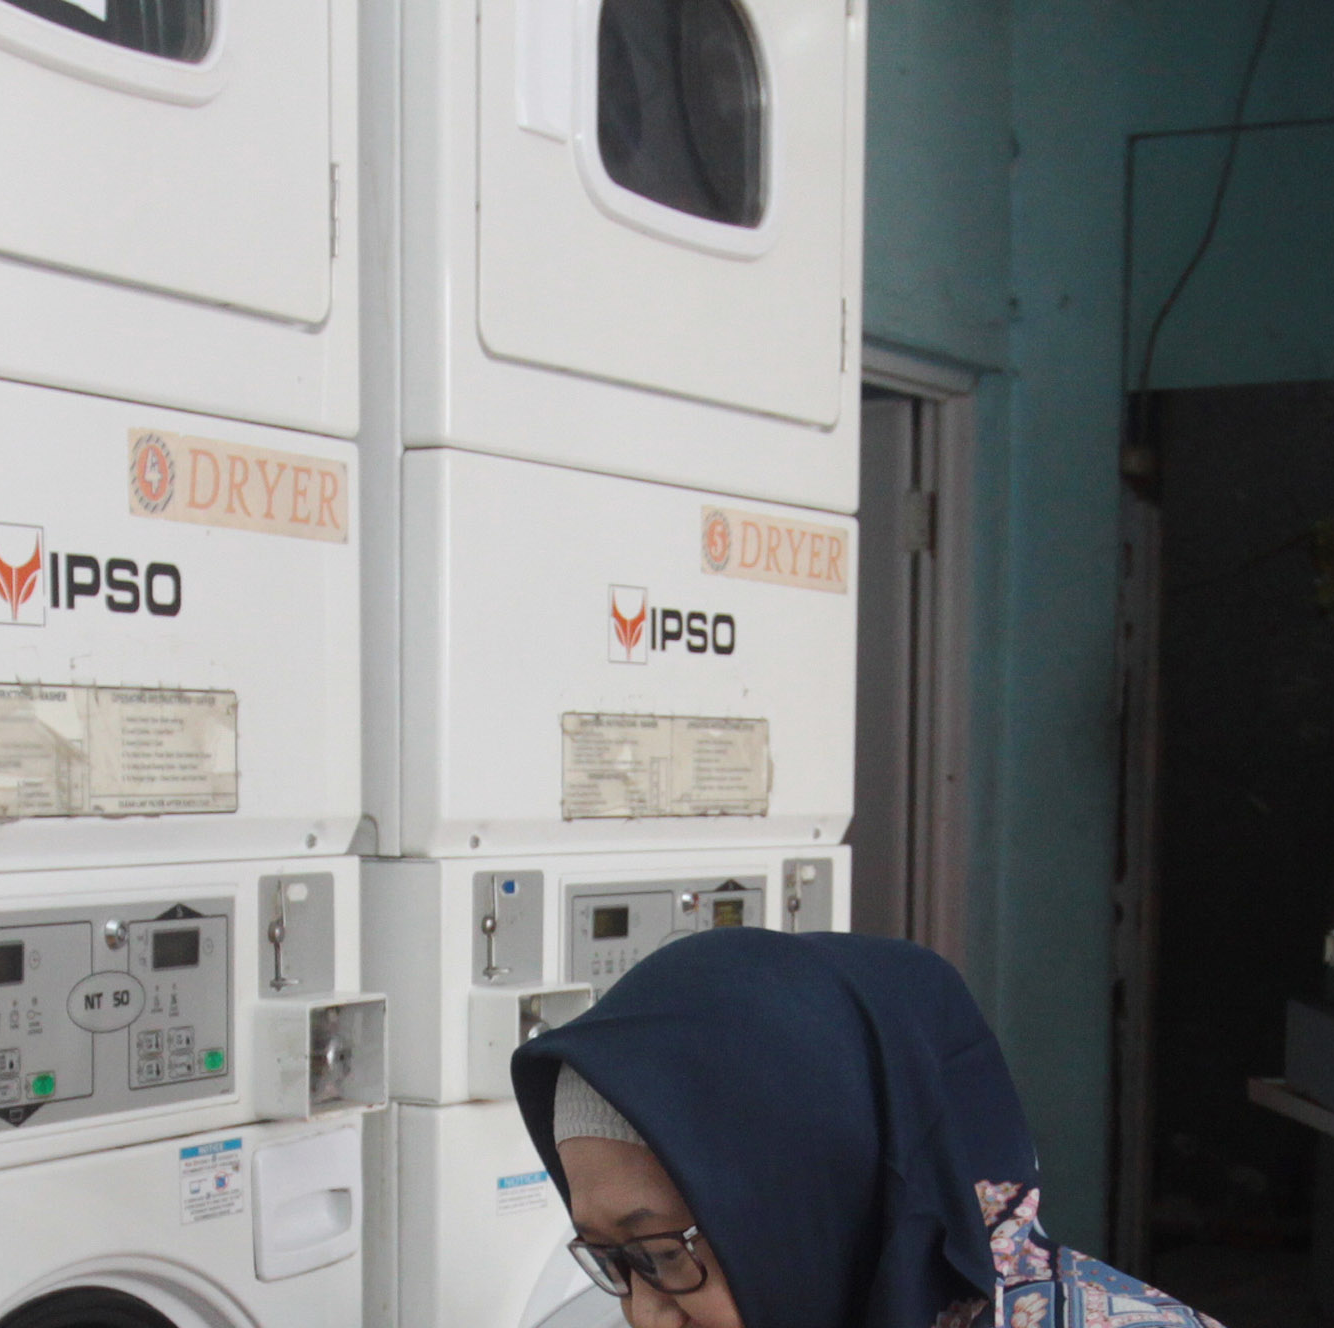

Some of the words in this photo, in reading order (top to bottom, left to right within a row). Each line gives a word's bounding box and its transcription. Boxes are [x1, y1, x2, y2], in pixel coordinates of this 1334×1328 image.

[186, 446, 341, 531] DRYER
[739, 519, 844, 583] DRYER
[49, 551, 182, 617] IPSO
[650, 607, 736, 656] IPSO
[84, 992, 103, 1010] NT
[113, 989, 130, 1007] 50
